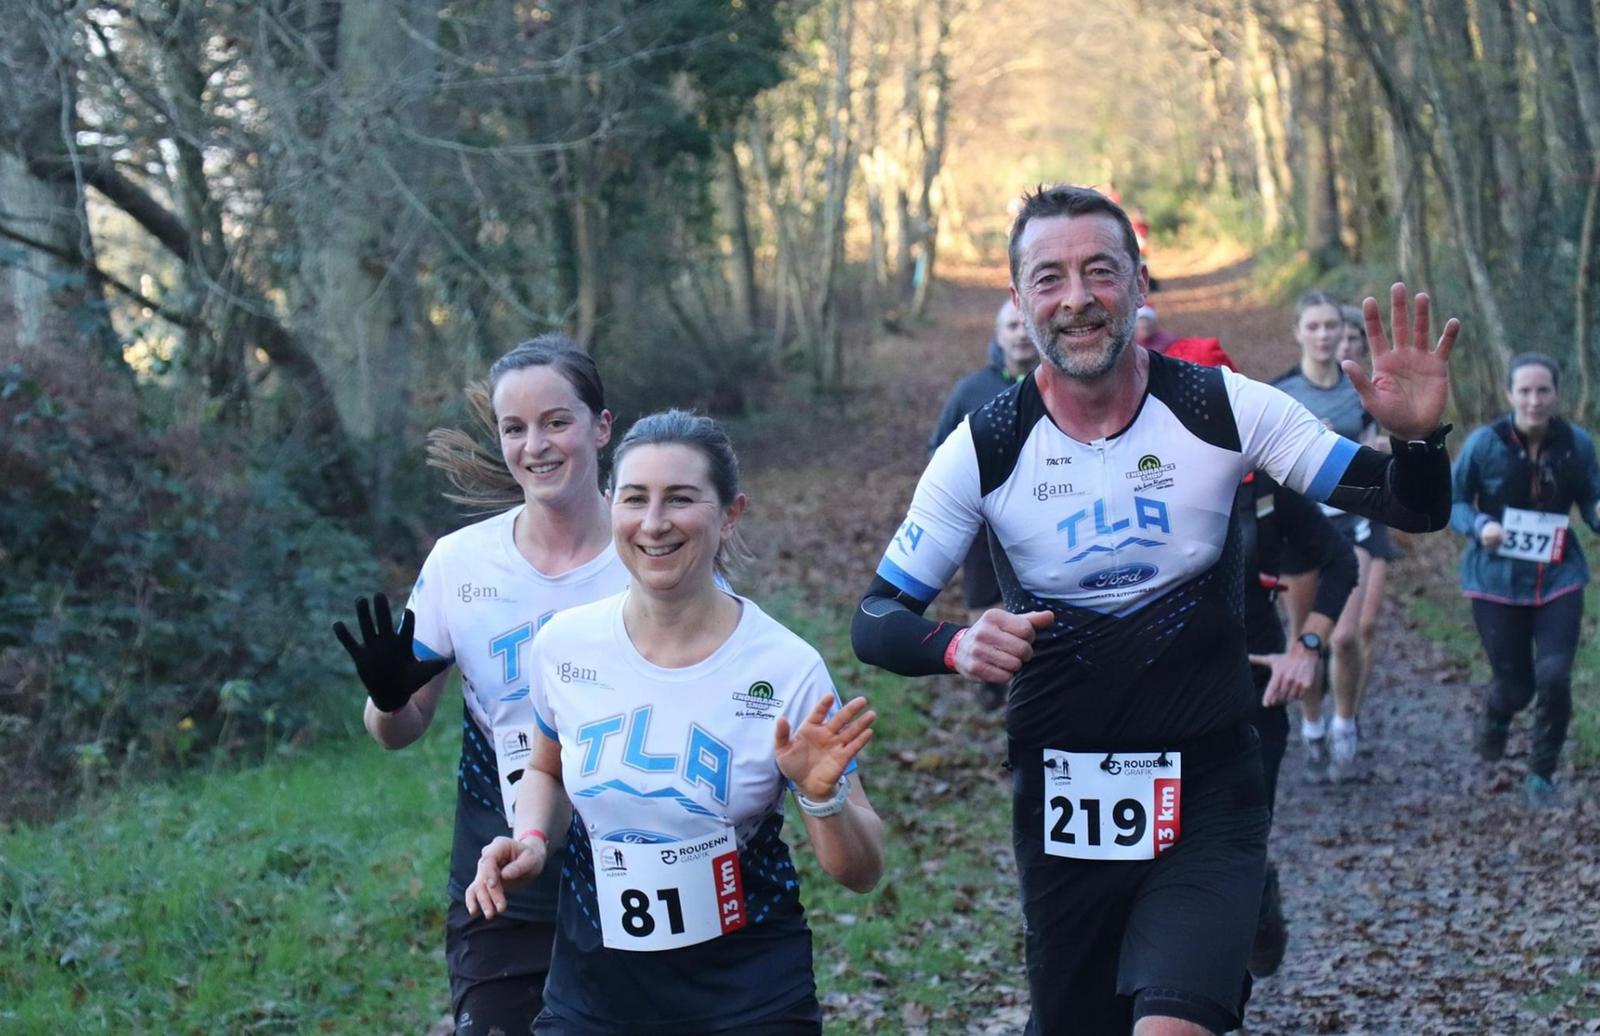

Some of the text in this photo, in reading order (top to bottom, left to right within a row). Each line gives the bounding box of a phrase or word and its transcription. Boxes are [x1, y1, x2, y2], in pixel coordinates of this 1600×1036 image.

[1046, 457, 1072, 466] TACTIC
[1125, 463, 1176, 479] ENDURANCE
[1033, 482, 1073, 501] igam
[1057, 496, 1170, 549] TLA
[1503, 529, 1550, 553] 337
[1096, 568, 1142, 588] Ford
[457, 583, 498, 603] igam
[557, 662, 597, 683] igam
[577, 705, 732, 806] TLA
[1124, 768, 1152, 776] GRAFIK
[1158, 786, 1175, 821] km
[1050, 796, 1147, 847] 219
[680, 836, 728, 855] ROUDENN
[681, 852, 710, 863] GRAFIK
[721, 860, 740, 925] 13 km
[621, 888, 685, 937] 81
